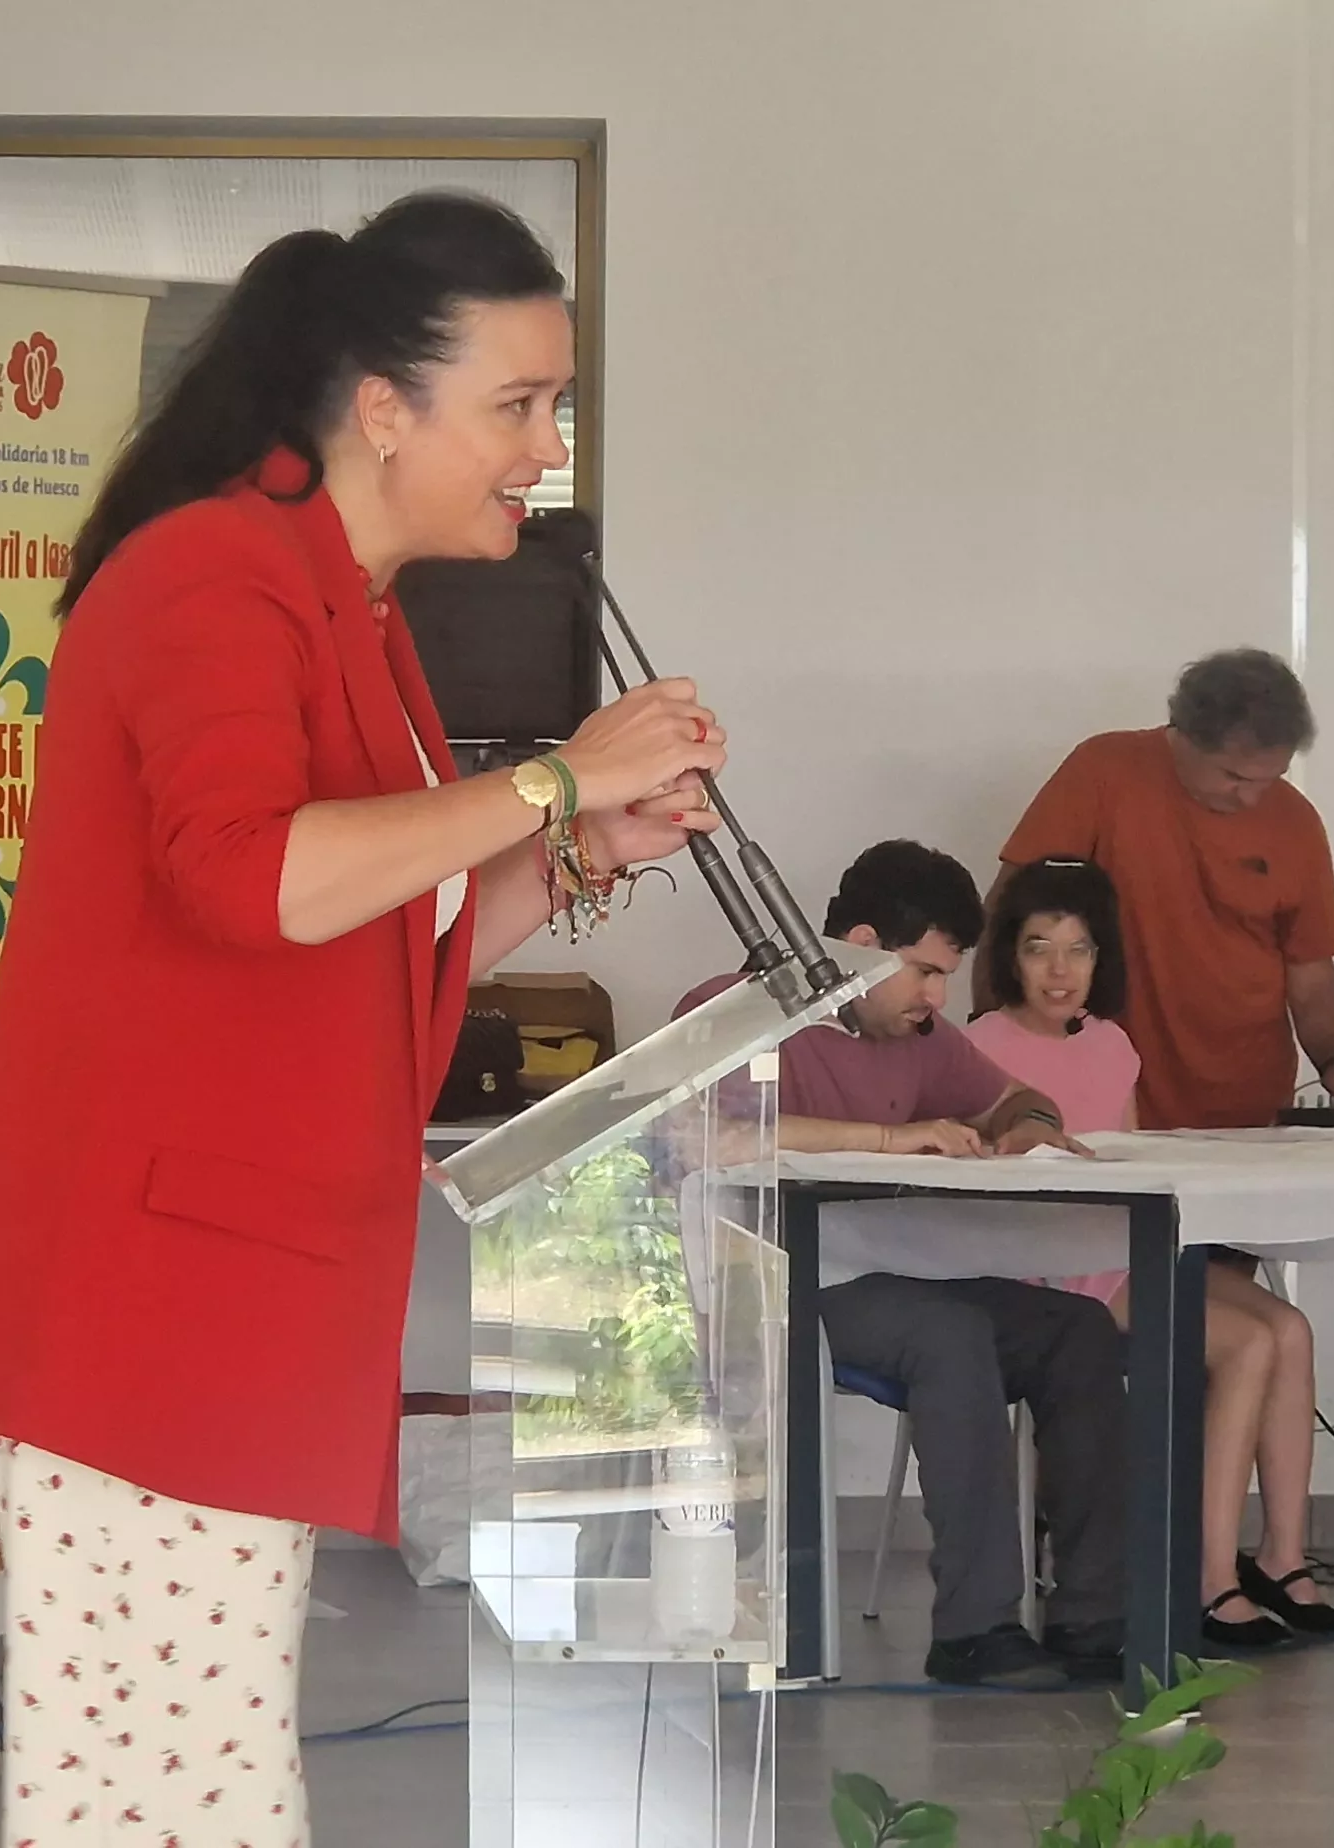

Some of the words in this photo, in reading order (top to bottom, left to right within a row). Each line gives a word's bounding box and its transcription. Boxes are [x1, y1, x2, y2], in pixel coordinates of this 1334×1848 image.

[52, 448, 66, 465] 18
[70, 448, 89, 467] km
[13, 476, 29, 494] de
[33, 477, 79, 497] Huesca
[26, 540, 37, 579] a
